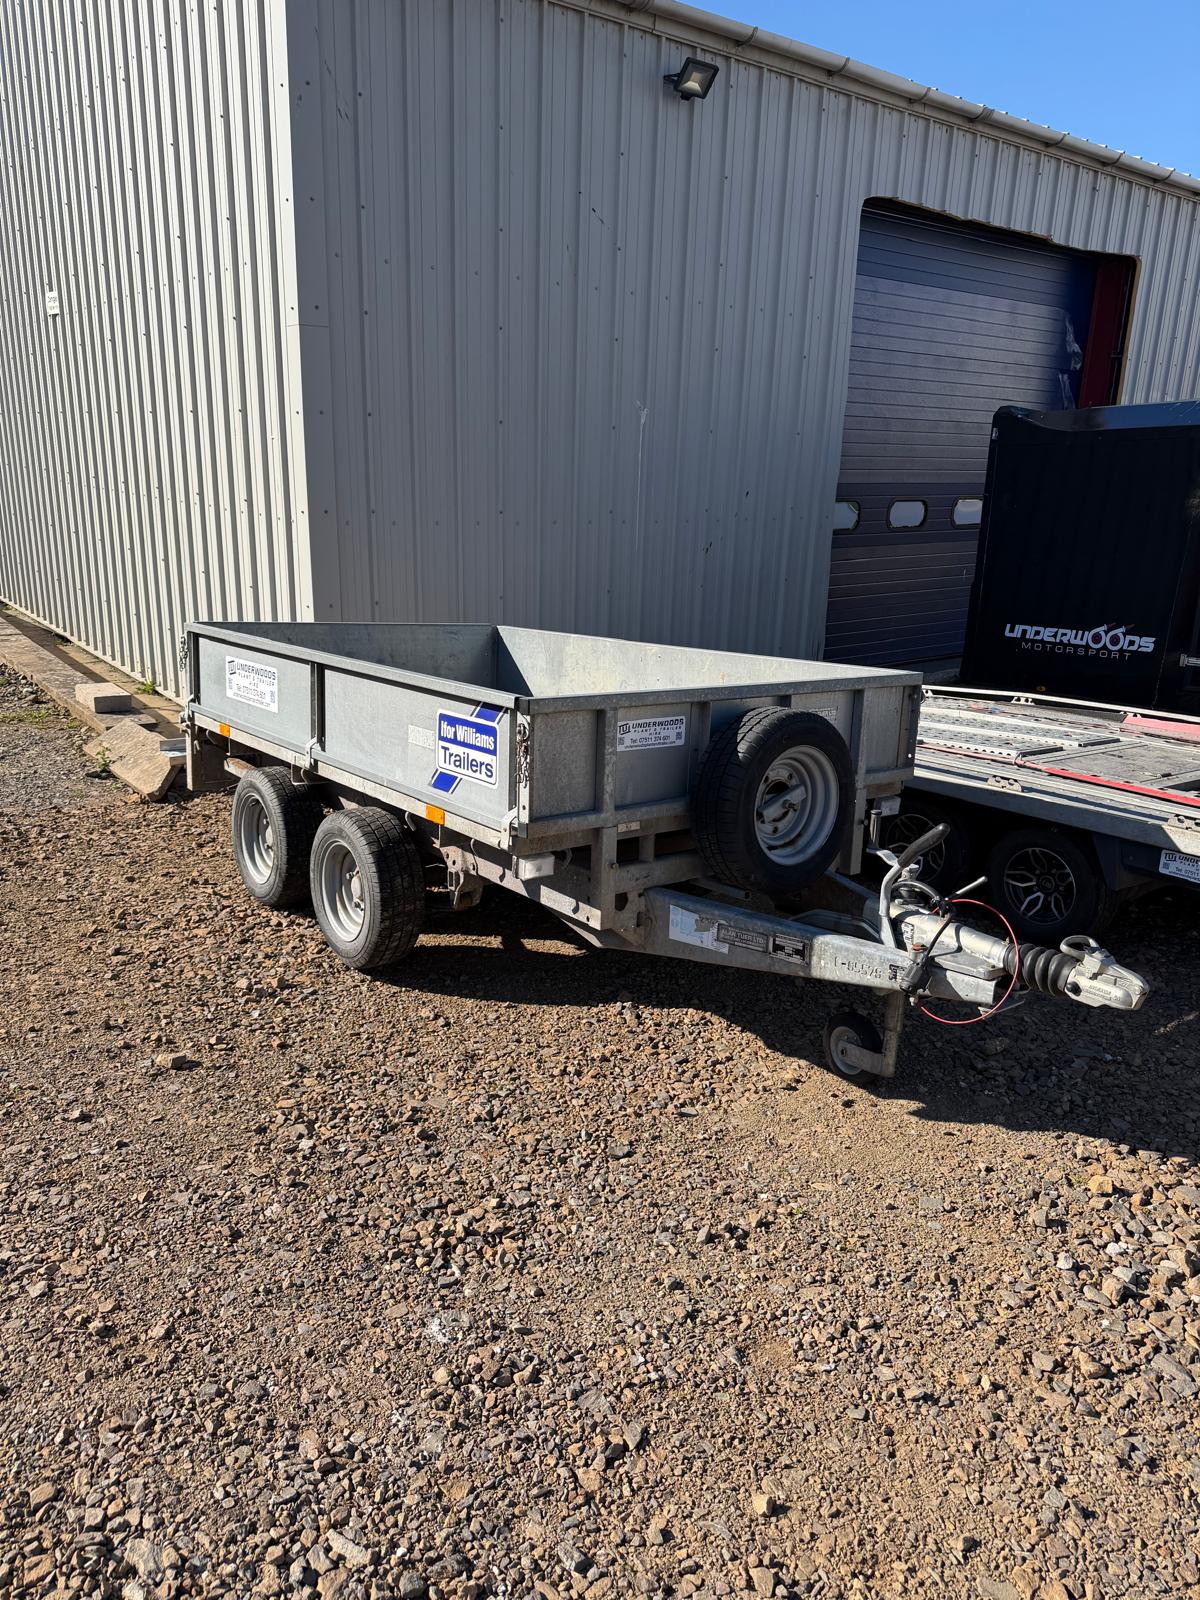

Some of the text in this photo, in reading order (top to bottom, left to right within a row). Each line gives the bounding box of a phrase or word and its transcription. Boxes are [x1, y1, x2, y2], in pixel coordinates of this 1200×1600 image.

[1004, 623, 1157, 652] UNDERWOODS
[1021, 641, 1131, 660] MOTORSPORT
[237, 662, 276, 681] UNDERWOODS
[441, 721, 455, 740] Ifor
[456, 724, 495, 750] Williams
[631, 718, 684, 729] UNDERWOODS
[441, 745, 494, 778] Trailers
